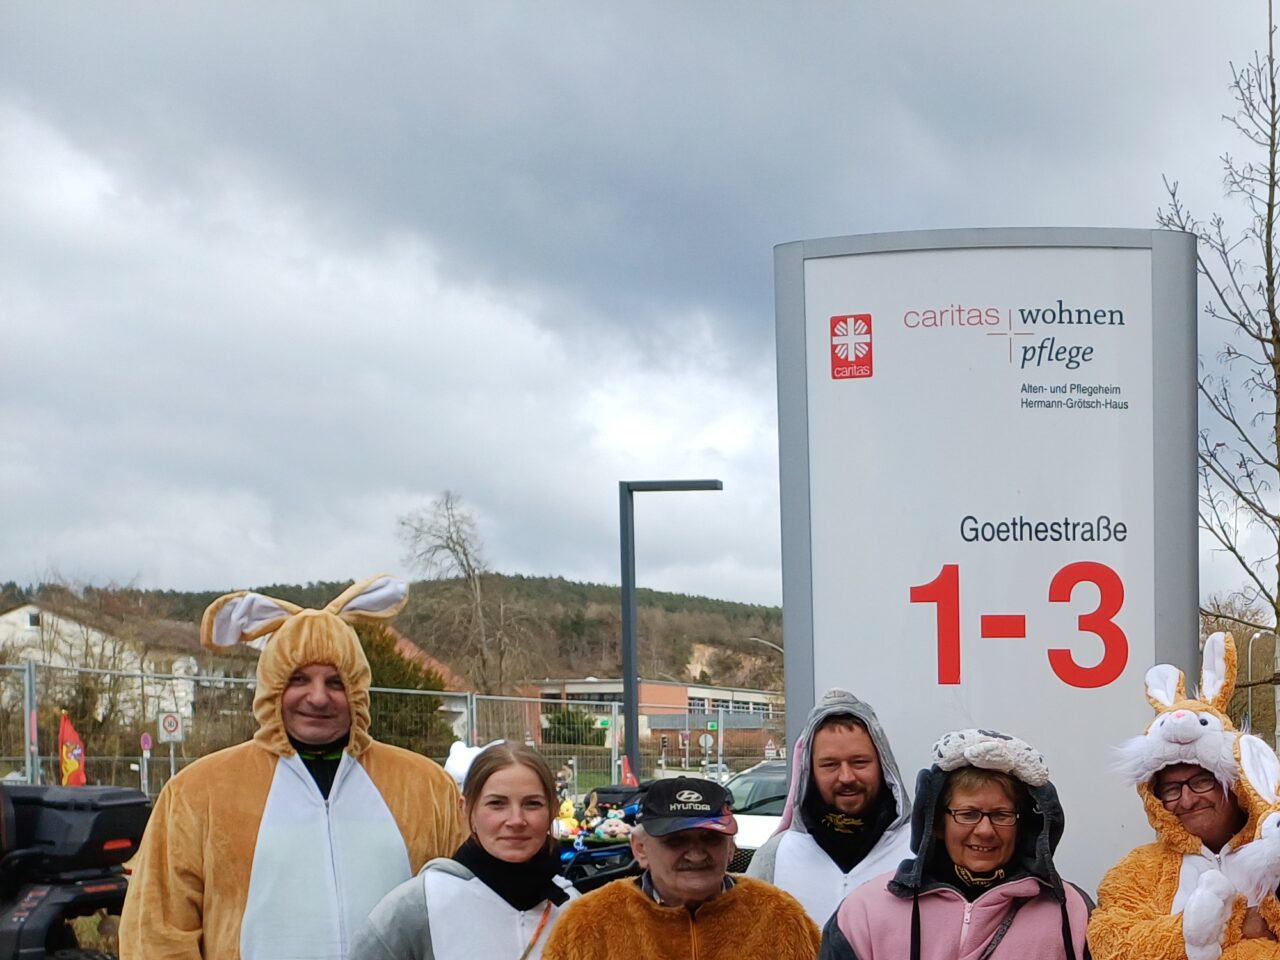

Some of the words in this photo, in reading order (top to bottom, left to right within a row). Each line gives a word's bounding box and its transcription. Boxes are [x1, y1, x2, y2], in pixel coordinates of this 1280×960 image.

[903, 304, 1000, 329] caritas
[1018, 300, 1126, 326] wohnen
[1020, 336, 1094, 370] pflege
[834, 363, 870, 378] caritas
[1020, 383, 1048, 394] Alten-
[1049, 383, 1067, 394] und
[1069, 383, 1121, 397] Pflegeheim
[960, 515, 1128, 542] Goethestraße
[670, 802, 711, 812] HYUNDAI
